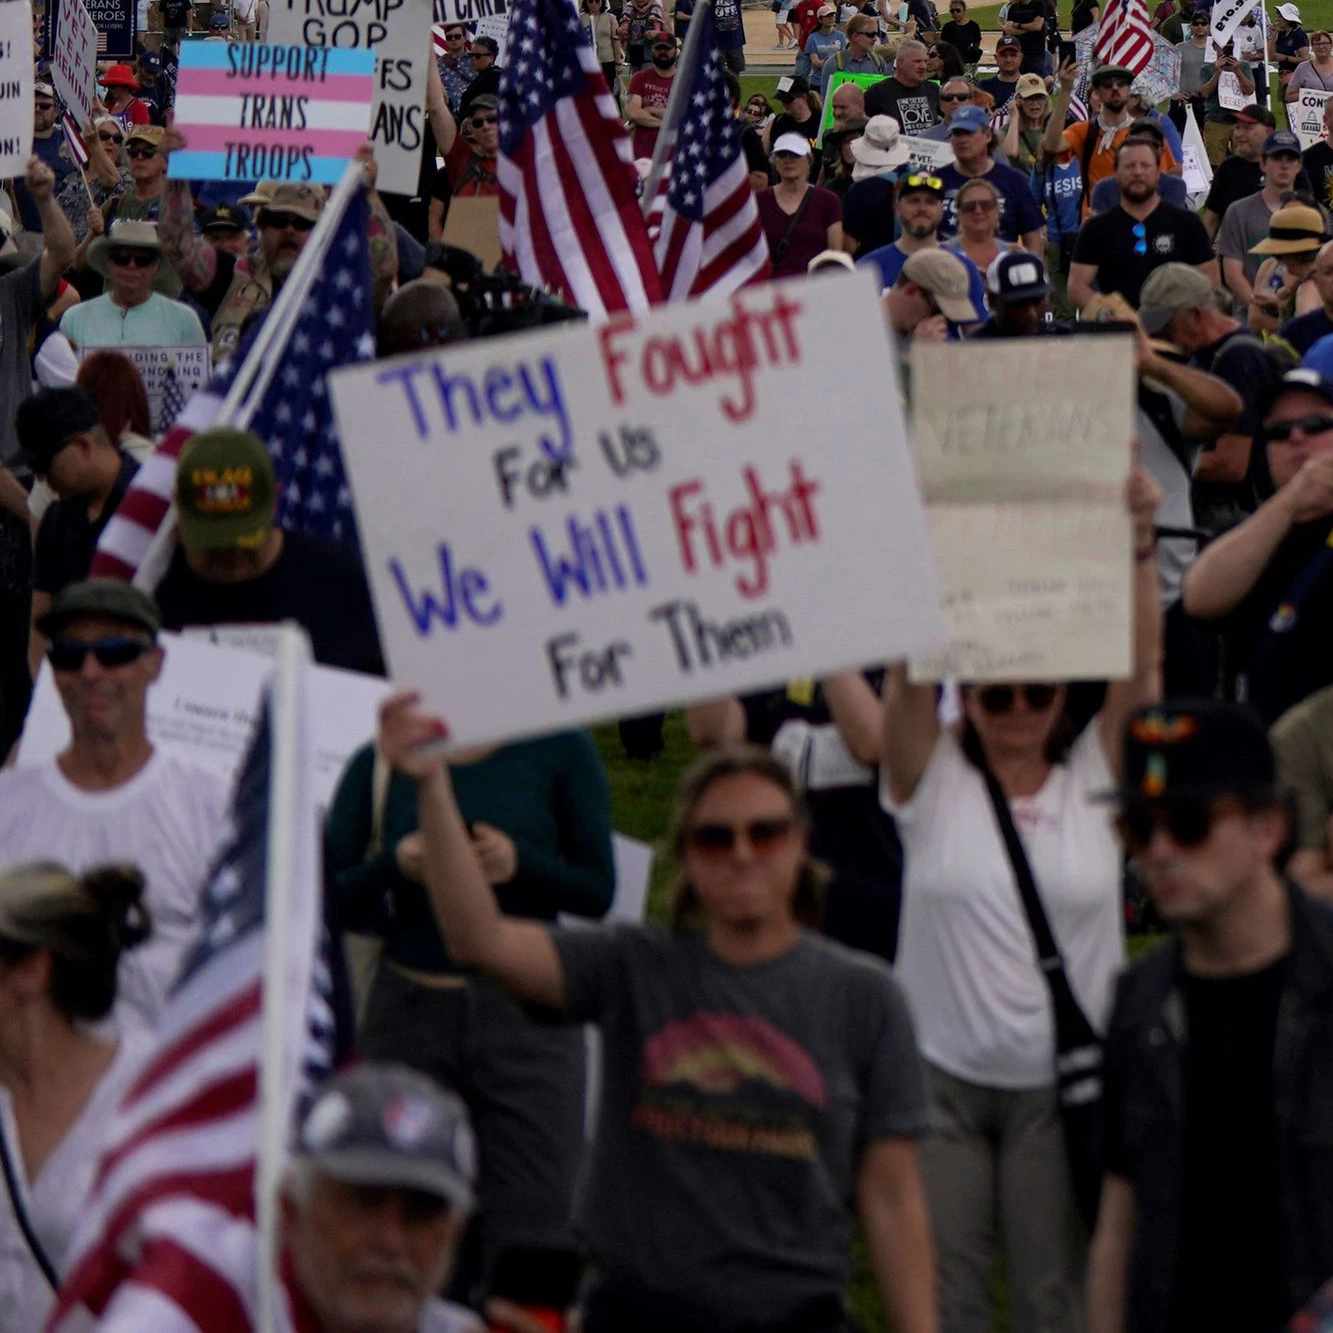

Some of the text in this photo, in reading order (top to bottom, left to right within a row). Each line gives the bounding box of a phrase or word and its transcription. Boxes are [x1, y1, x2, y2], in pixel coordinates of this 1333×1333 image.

[84, 0, 121, 10] ERANS
[302, 18, 388, 50] GOP
[226, 43, 331, 83] SUPPORT
[239, 93, 309, 131] TRANS
[224, 141, 314, 182] TROOPS
[1045, 177, 1085, 198] RESIS
[377, 290, 806, 461] They Fought
[492, 423, 662, 510] For Us
[387, 541, 505, 638] We
[529, 503, 650, 609] Will
[667, 458, 820, 600] Fight
[545, 598, 794, 702] For Them
